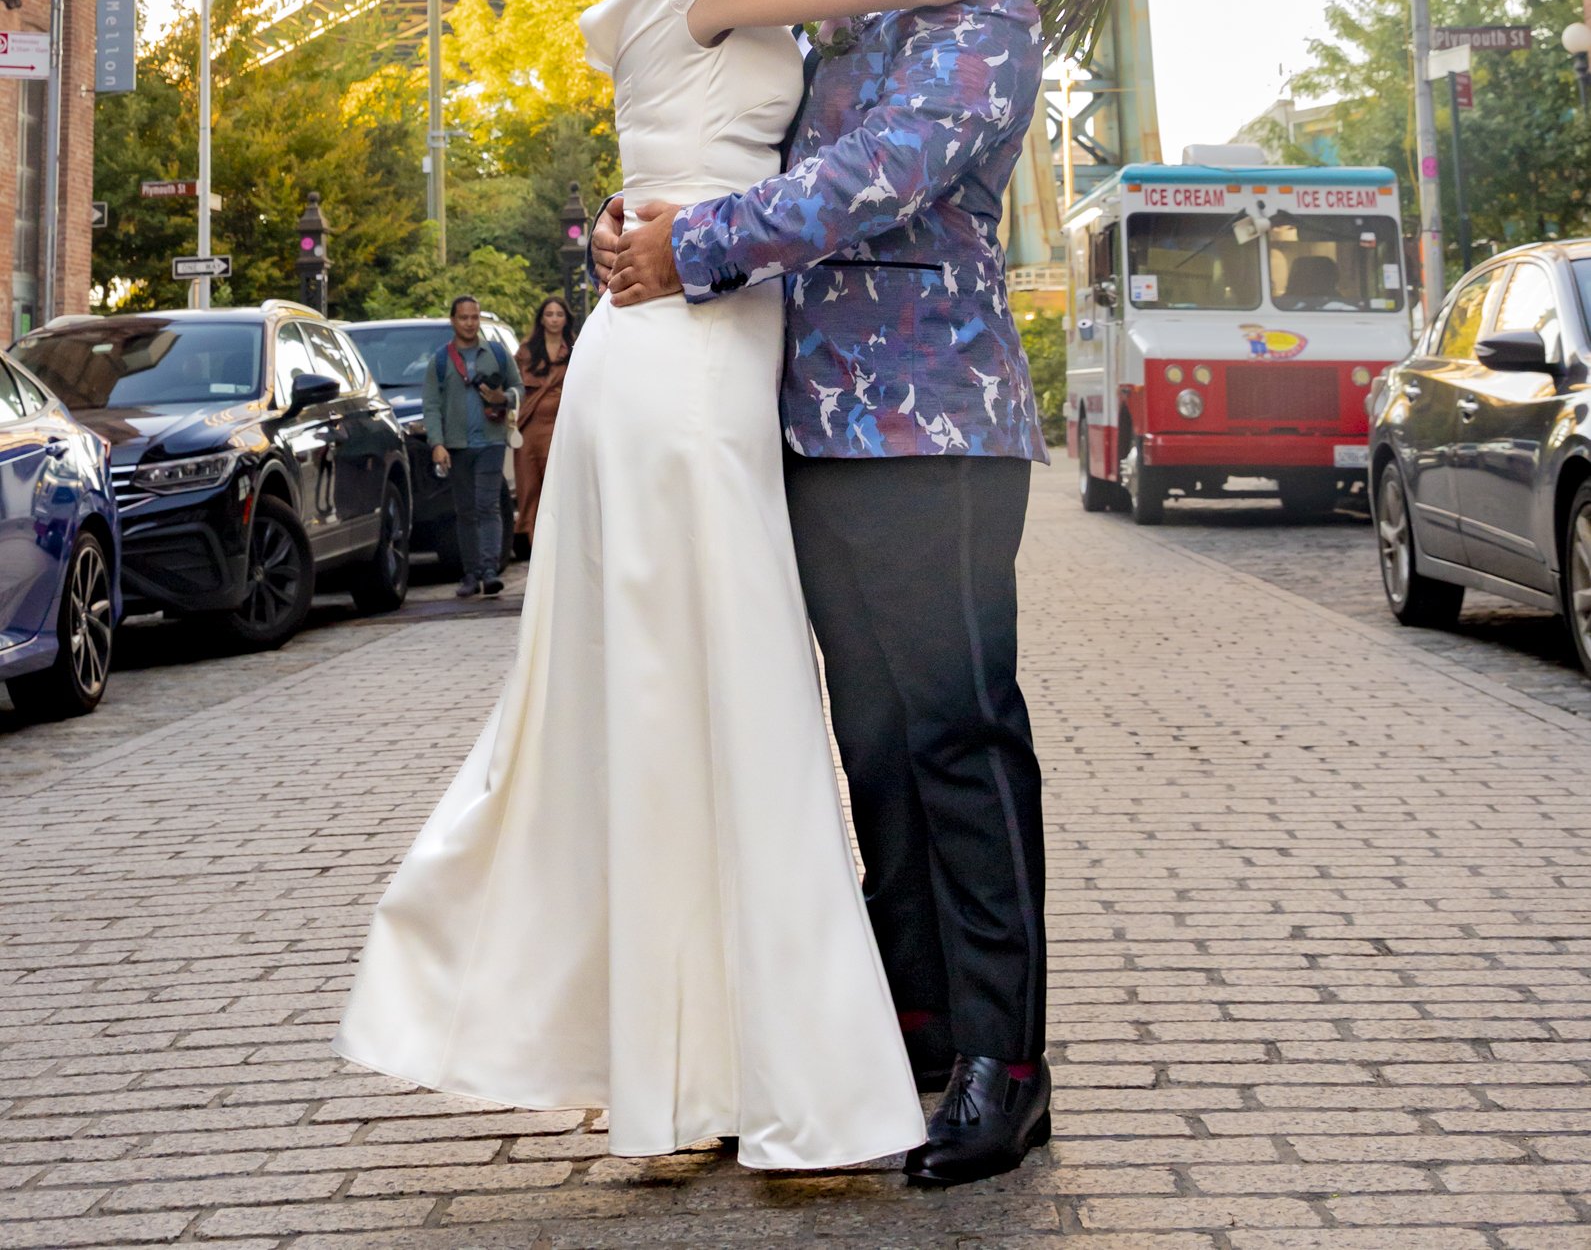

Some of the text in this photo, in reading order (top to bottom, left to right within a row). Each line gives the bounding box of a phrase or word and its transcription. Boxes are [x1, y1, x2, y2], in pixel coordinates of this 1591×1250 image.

[105, 1, 120, 86] Mellon
[1436, 30, 1525, 47] Plymouth St
[1144, 189, 1225, 207] ICE CREAM
[1296, 190, 1377, 208] ICE CREAM
